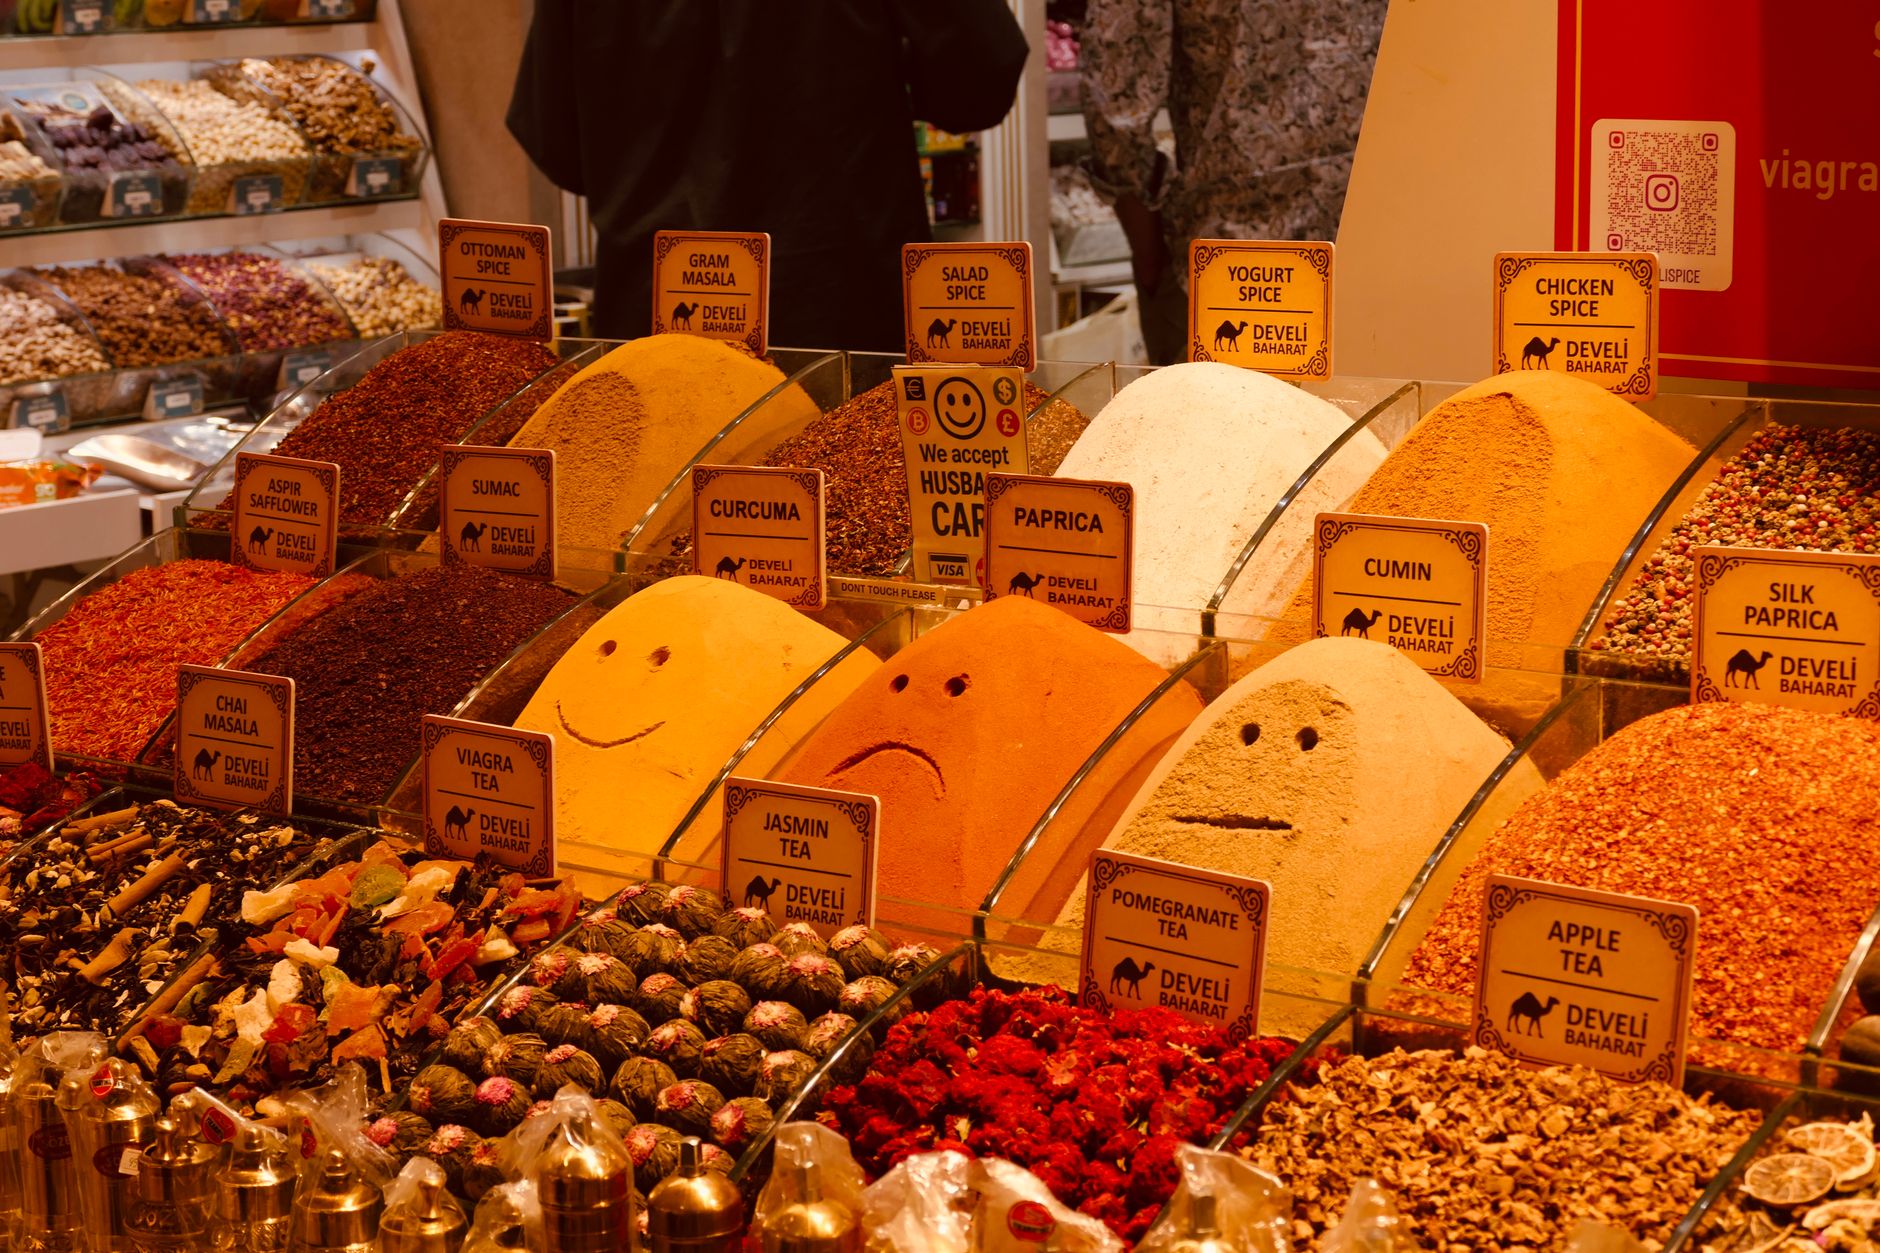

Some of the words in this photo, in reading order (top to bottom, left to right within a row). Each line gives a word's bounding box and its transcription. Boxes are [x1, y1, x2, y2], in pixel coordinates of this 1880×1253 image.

[1760, 148, 1878, 200] viagra
[461, 242, 525, 260] OTTOMAN
[689, 254, 729, 268] GRAM
[477, 260, 510, 275] SPICE
[942, 266, 989, 281] SALAD
[1228, 266, 1294, 283] YOGURT
[682, 271, 736, 286] MASALA
[1535, 278, 1614, 296] CHICKEN
[490, 292, 532, 308] DEVELİ
[947, 285, 986, 300] SPICE
[1239, 286, 1281, 302] SPICE
[491, 308, 533, 320] BAHARAT
[703, 303, 746, 320] DEVELİ
[1549, 299, 1599, 317] SPICE
[702, 322, 746, 333] BAHARAT
[961, 318, 1010, 336] DEVELİ
[1253, 322, 1307, 342] DEVELİ
[962, 339, 1011, 349] BAHARAT
[1253, 343, 1307, 355] BAHARAT
[1566, 338, 1628, 359] DEVELİ
[1566, 360, 1628, 374] BAHARAT
[919, 443, 947, 463] We
[953, 446, 1010, 468] accept
[268, 478, 301, 496] ASPIR
[472, 479, 520, 497] SUMAC
[250, 493, 318, 517] SAFFLOWER
[710, 499, 800, 521] CURCUMA
[1014, 507, 1104, 533] PAPRICA
[276, 548, 316, 563] BAHARAT
[491, 543, 535, 557] BAHARAT
[937, 563, 964, 577] VISA
[1364, 558, 1431, 581] CUMIN
[749, 574, 807, 587] BAHARAT
[841, 582, 865, 593] DONT
[867, 585, 899, 597] TOUCH
[901, 588, 936, 601] PLEASE
[1048, 592, 1114, 608] BAHARAT
[1768, 582, 1814, 604] SILK
[1388, 614, 1454, 638] DEVELİ
[1744, 606, 1838, 631] PAPRICA
[1388, 636, 1453, 654] BAHARAT
[1780, 656, 1856, 681] DEVELİ
[1780, 679, 1857, 698] BAHARAT
[216, 695, 247, 715] CHAI
[204, 713, 259, 737] MASALA
[225, 755, 269, 777] DEVELİ
[456, 747, 513, 773] VIAGRA
[224, 774, 269, 792] BAHARAT
[471, 771, 499, 792] TEA
[480, 813, 530, 839] DEVELİ
[763, 812, 828, 839] JASMIN
[480, 833, 530, 854] BAHARAT
[780, 838, 811, 860] TEA
[786, 883, 845, 910] DEVELİ
[785, 905, 844, 926] BAHARAT
[1112, 889, 1239, 930] POMEGRANATE
[1158, 918, 1188, 940] TEA
[1548, 920, 1621, 952] APPLE
[1560, 949, 1603, 978] TEA
[1160, 969, 1230, 1003] DEVELİ
[1159, 991, 1228, 1020] BAHARAT
[1566, 1003, 1648, 1039] DEVELİ
[1564, 1029, 1647, 1058] BAHARAT
